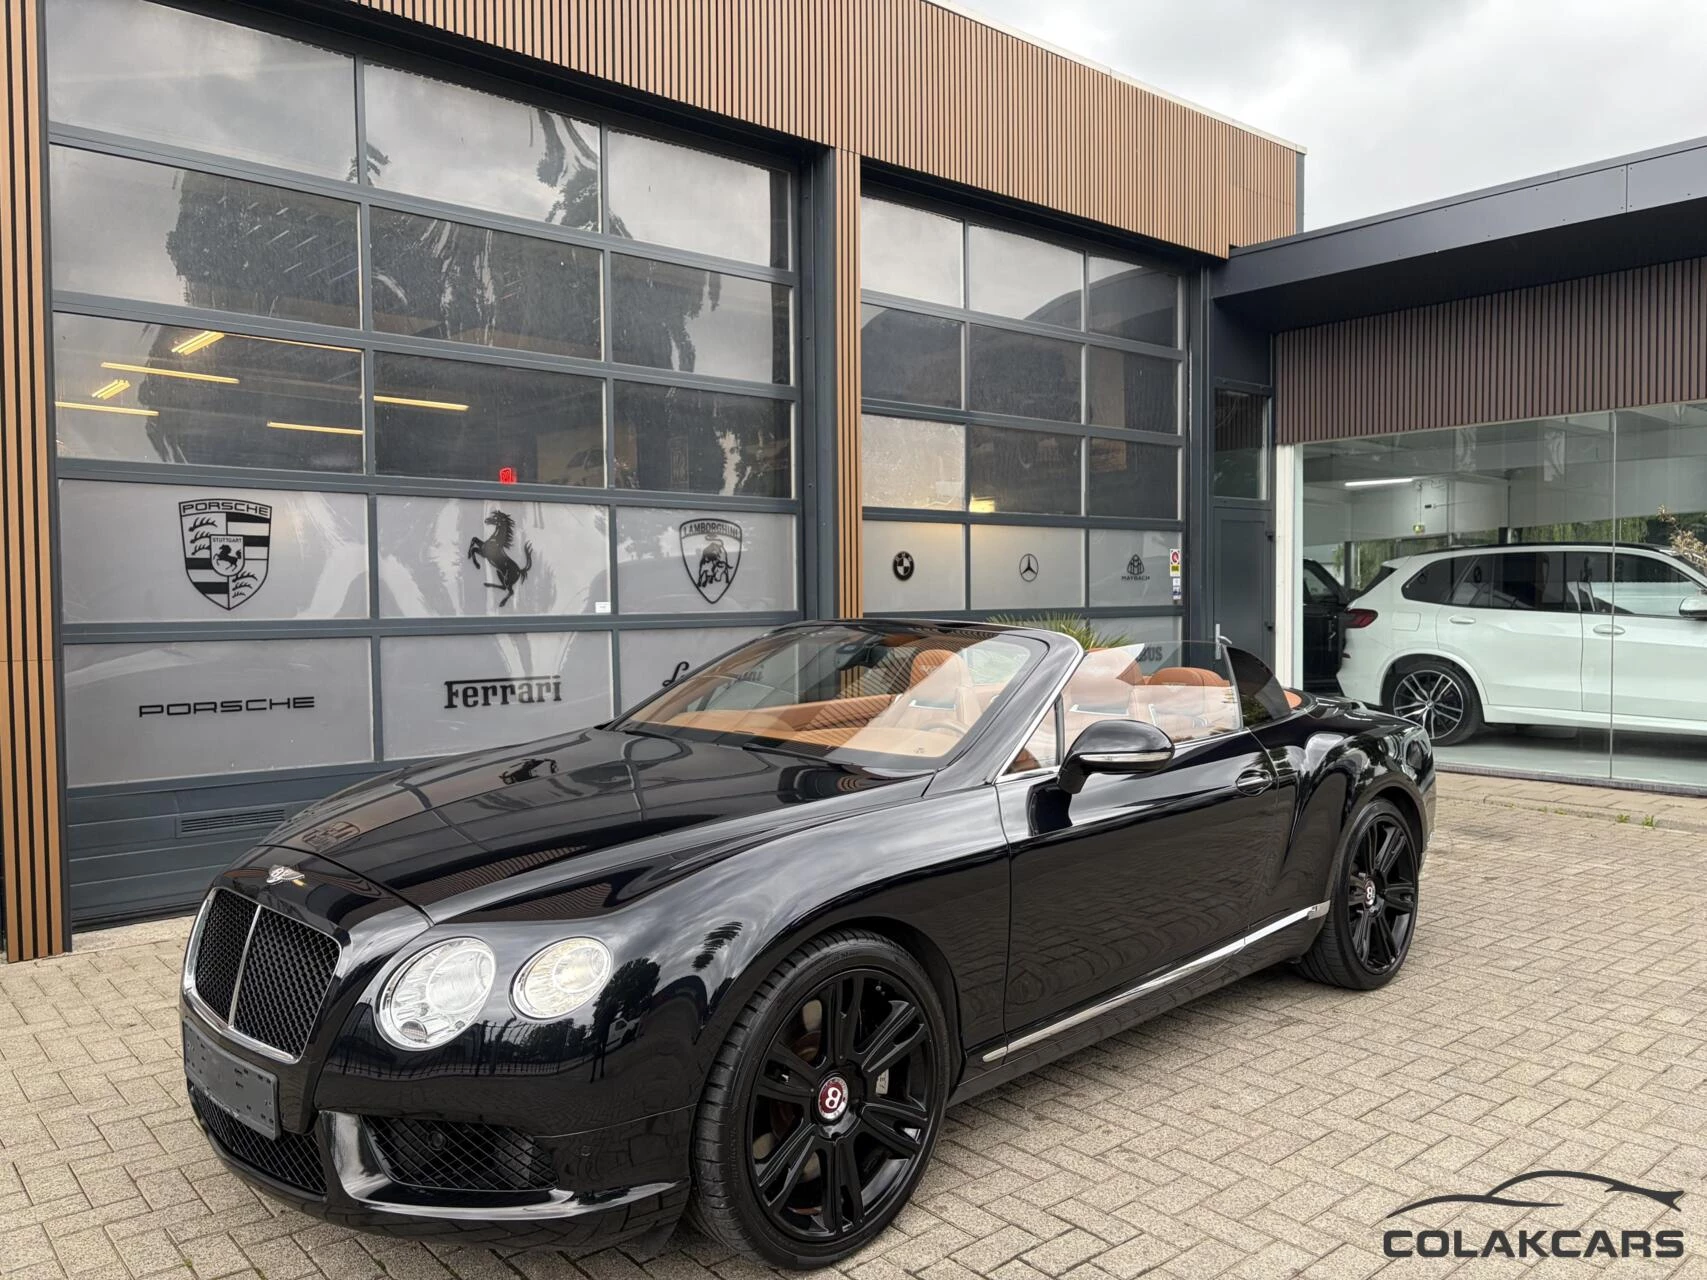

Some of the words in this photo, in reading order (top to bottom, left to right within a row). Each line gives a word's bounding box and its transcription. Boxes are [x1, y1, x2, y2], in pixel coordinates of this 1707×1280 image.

[182, 502, 269, 517] PORSCHE
[683, 522, 739, 537] LAMBORGHINI
[444, 675, 562, 709] Ferrari
[139, 696, 314, 718] PORSCHE
